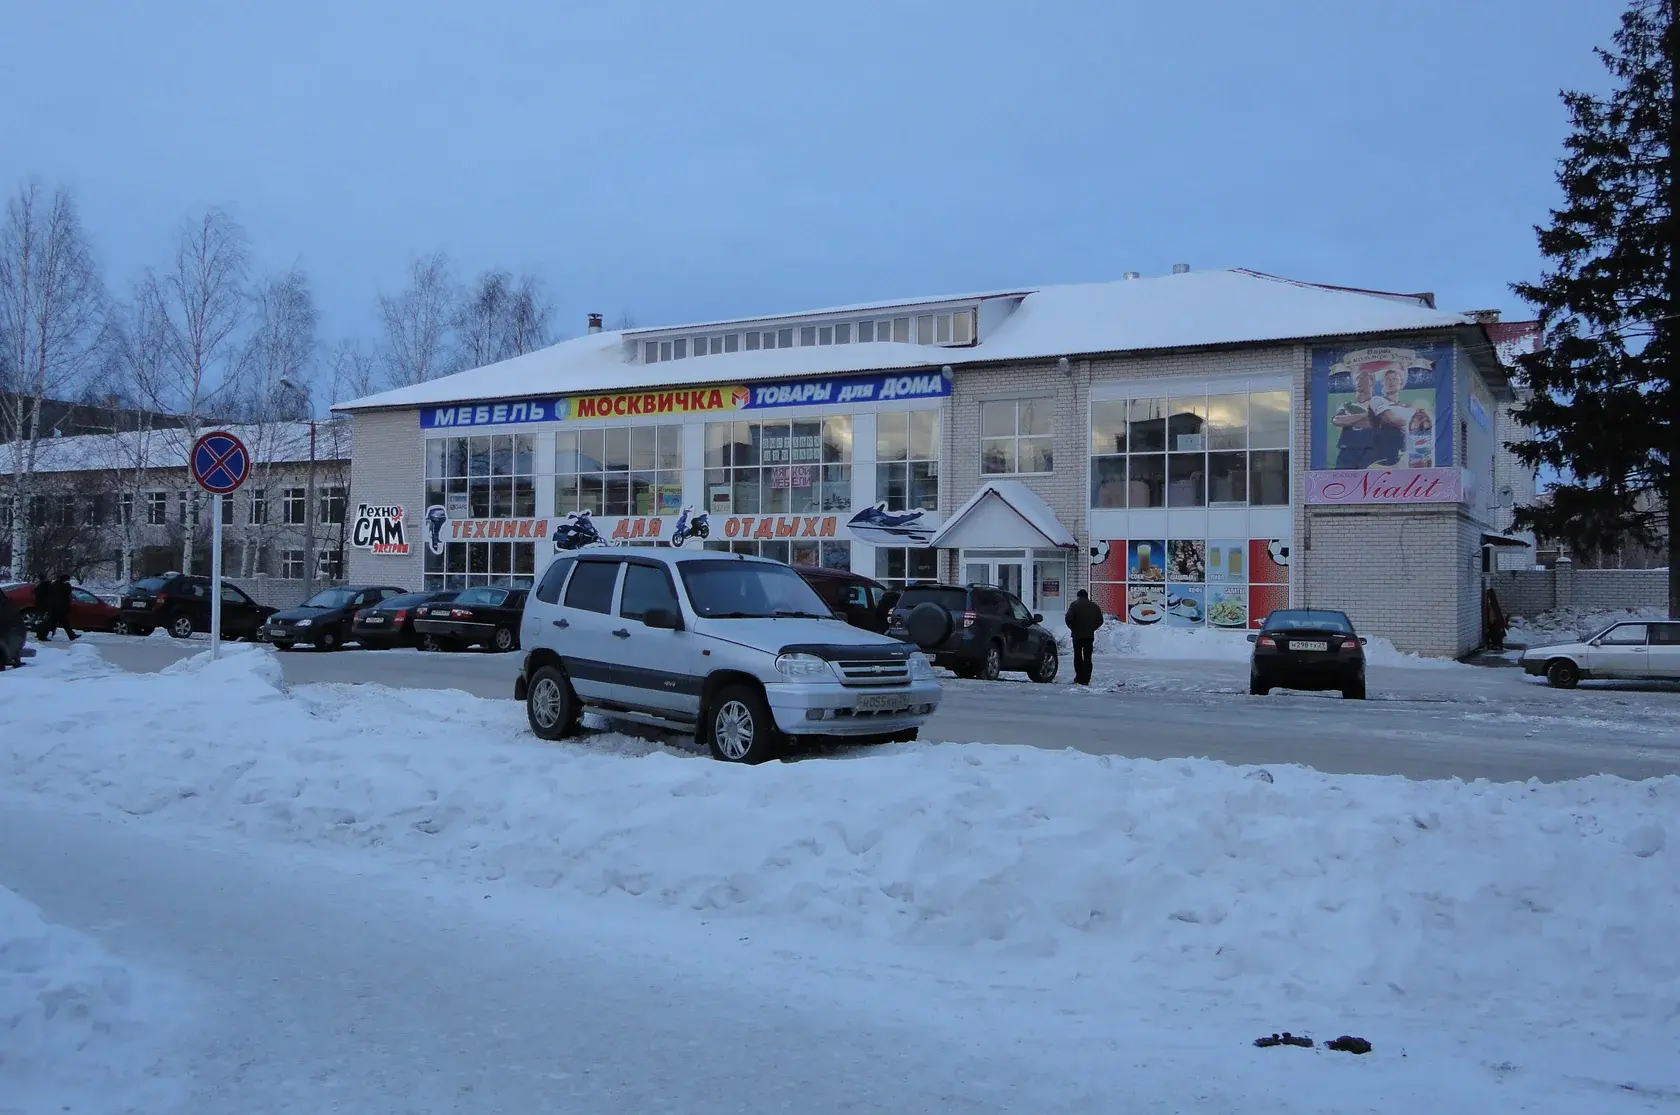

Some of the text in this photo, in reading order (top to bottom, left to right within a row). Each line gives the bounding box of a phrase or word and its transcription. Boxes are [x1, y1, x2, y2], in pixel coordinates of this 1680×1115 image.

[577, 389, 724, 418] МОСКВИЧКА
[755, 374, 943, 405] ТОВАРЫ для ДОМА
[433, 402, 545, 427] МЕБЕЛЬ
[1322, 471, 1443, 500] Nialit
[358, 504, 399, 517] Техно
[353, 517, 404, 546] САМ
[452, 516, 837, 539] ТЕХНИКА ДЛЯ ОТДЫХА
